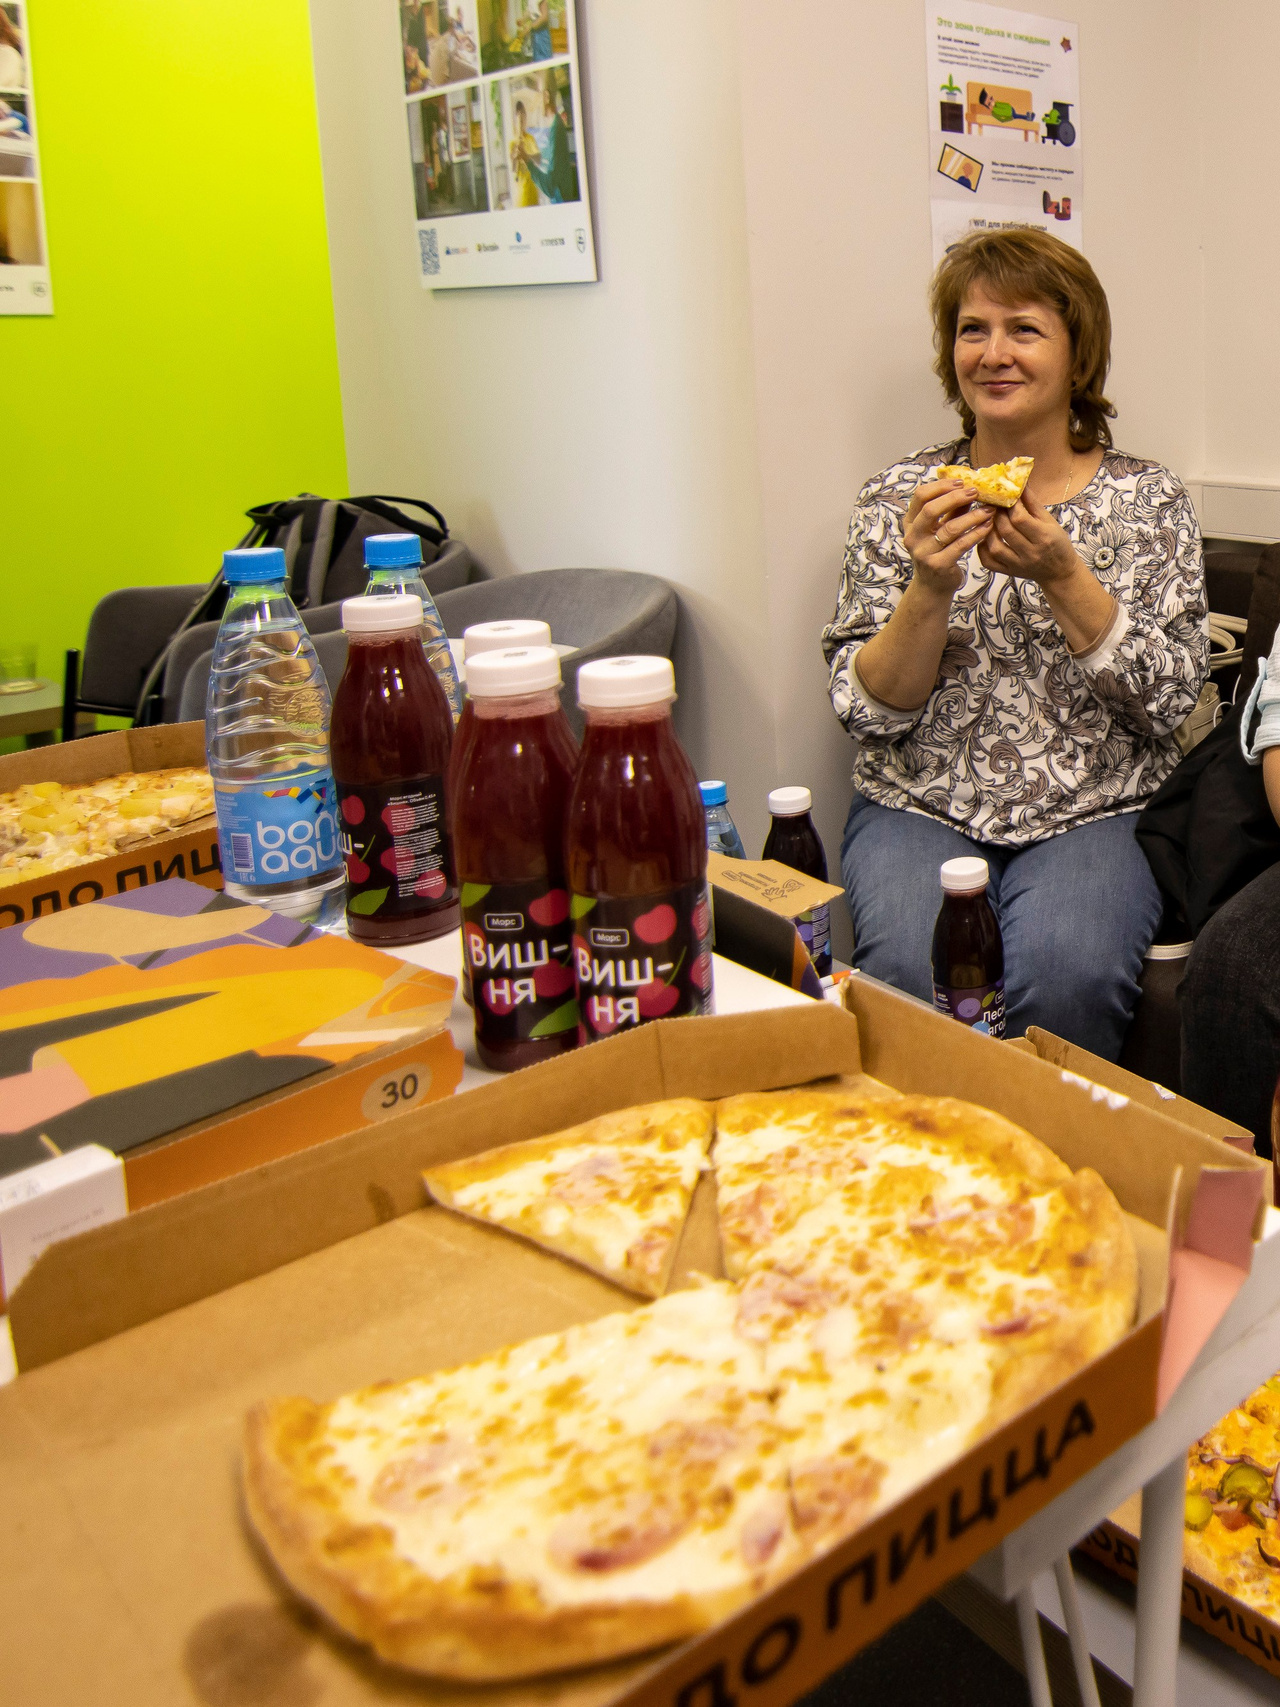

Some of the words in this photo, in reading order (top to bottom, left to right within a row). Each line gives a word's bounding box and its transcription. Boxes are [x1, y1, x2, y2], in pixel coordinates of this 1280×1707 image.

[491, 917, 516, 927] Морс
[596, 933, 622, 943] Морс
[381, 1073, 418, 1108] 30
[825, 1399, 1096, 1633] ПИЦЦА
